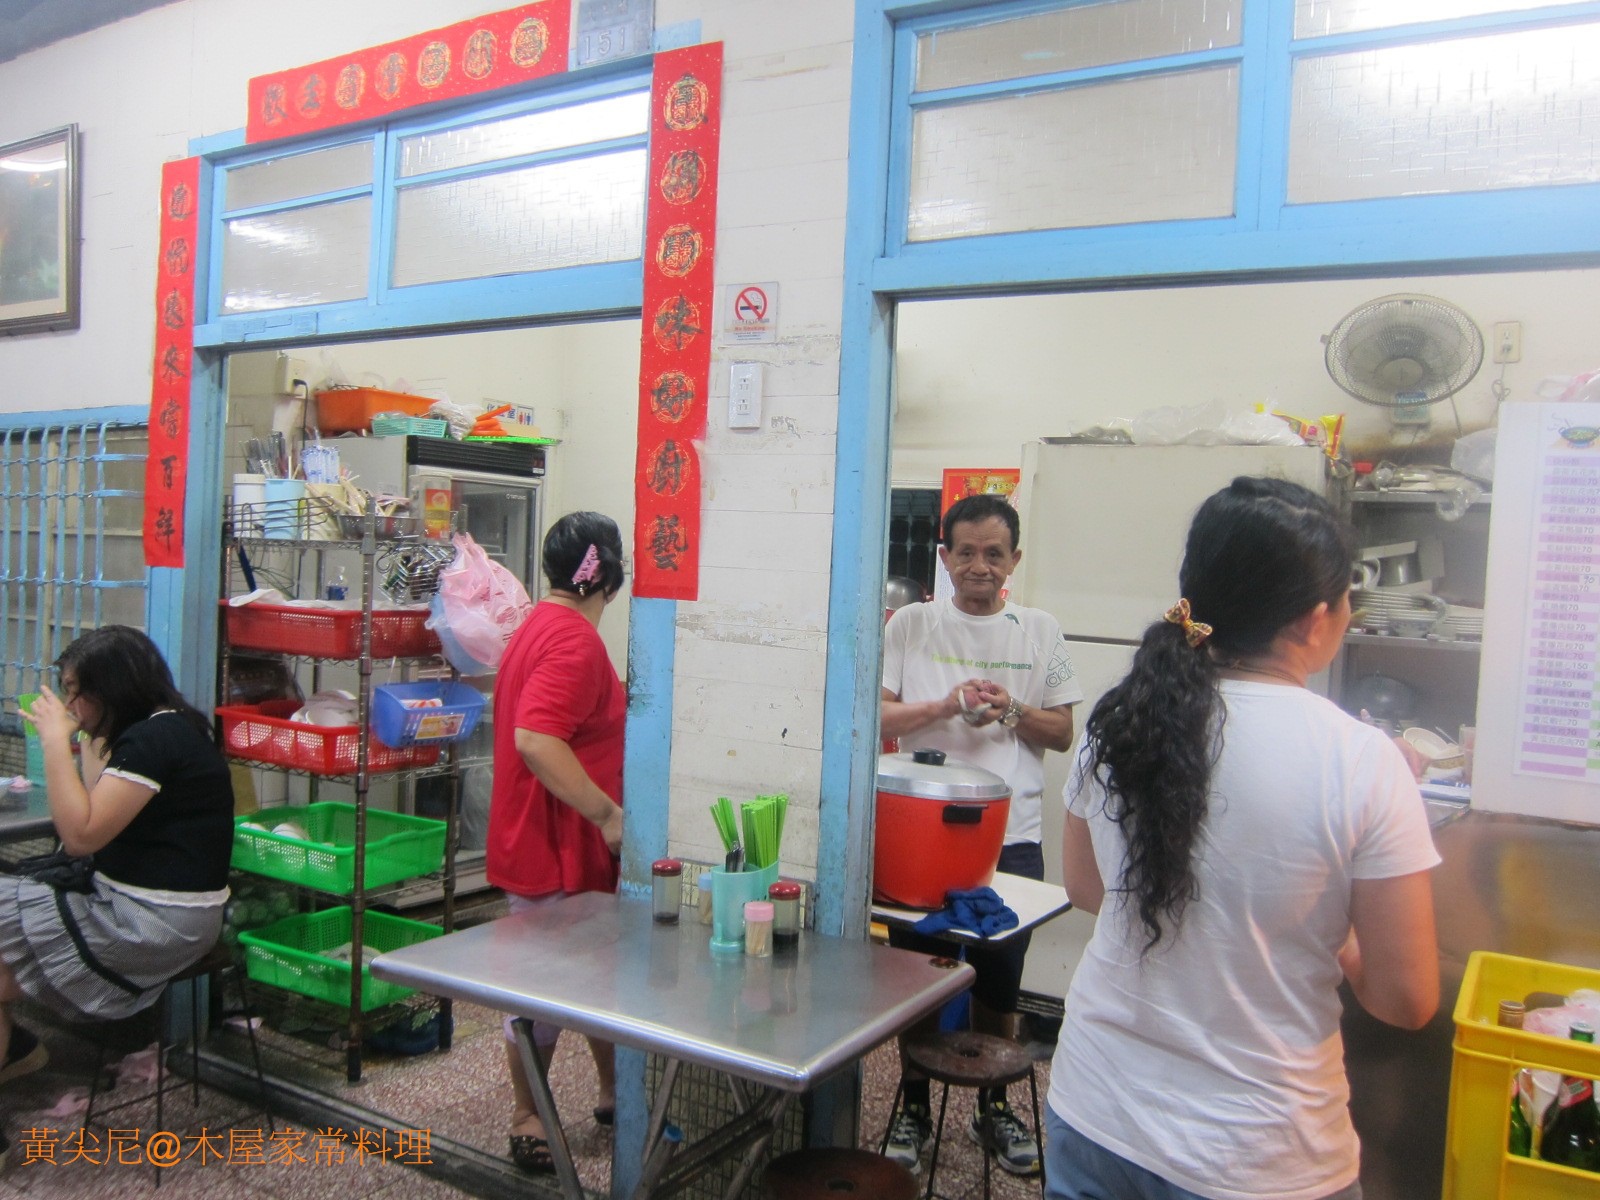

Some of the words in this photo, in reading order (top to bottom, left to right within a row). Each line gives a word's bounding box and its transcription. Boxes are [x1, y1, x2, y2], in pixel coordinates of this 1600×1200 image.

[584, 27, 625, 60] 151
[975, 661, 988, 669] city
[990, 661, 1032, 670] performance
